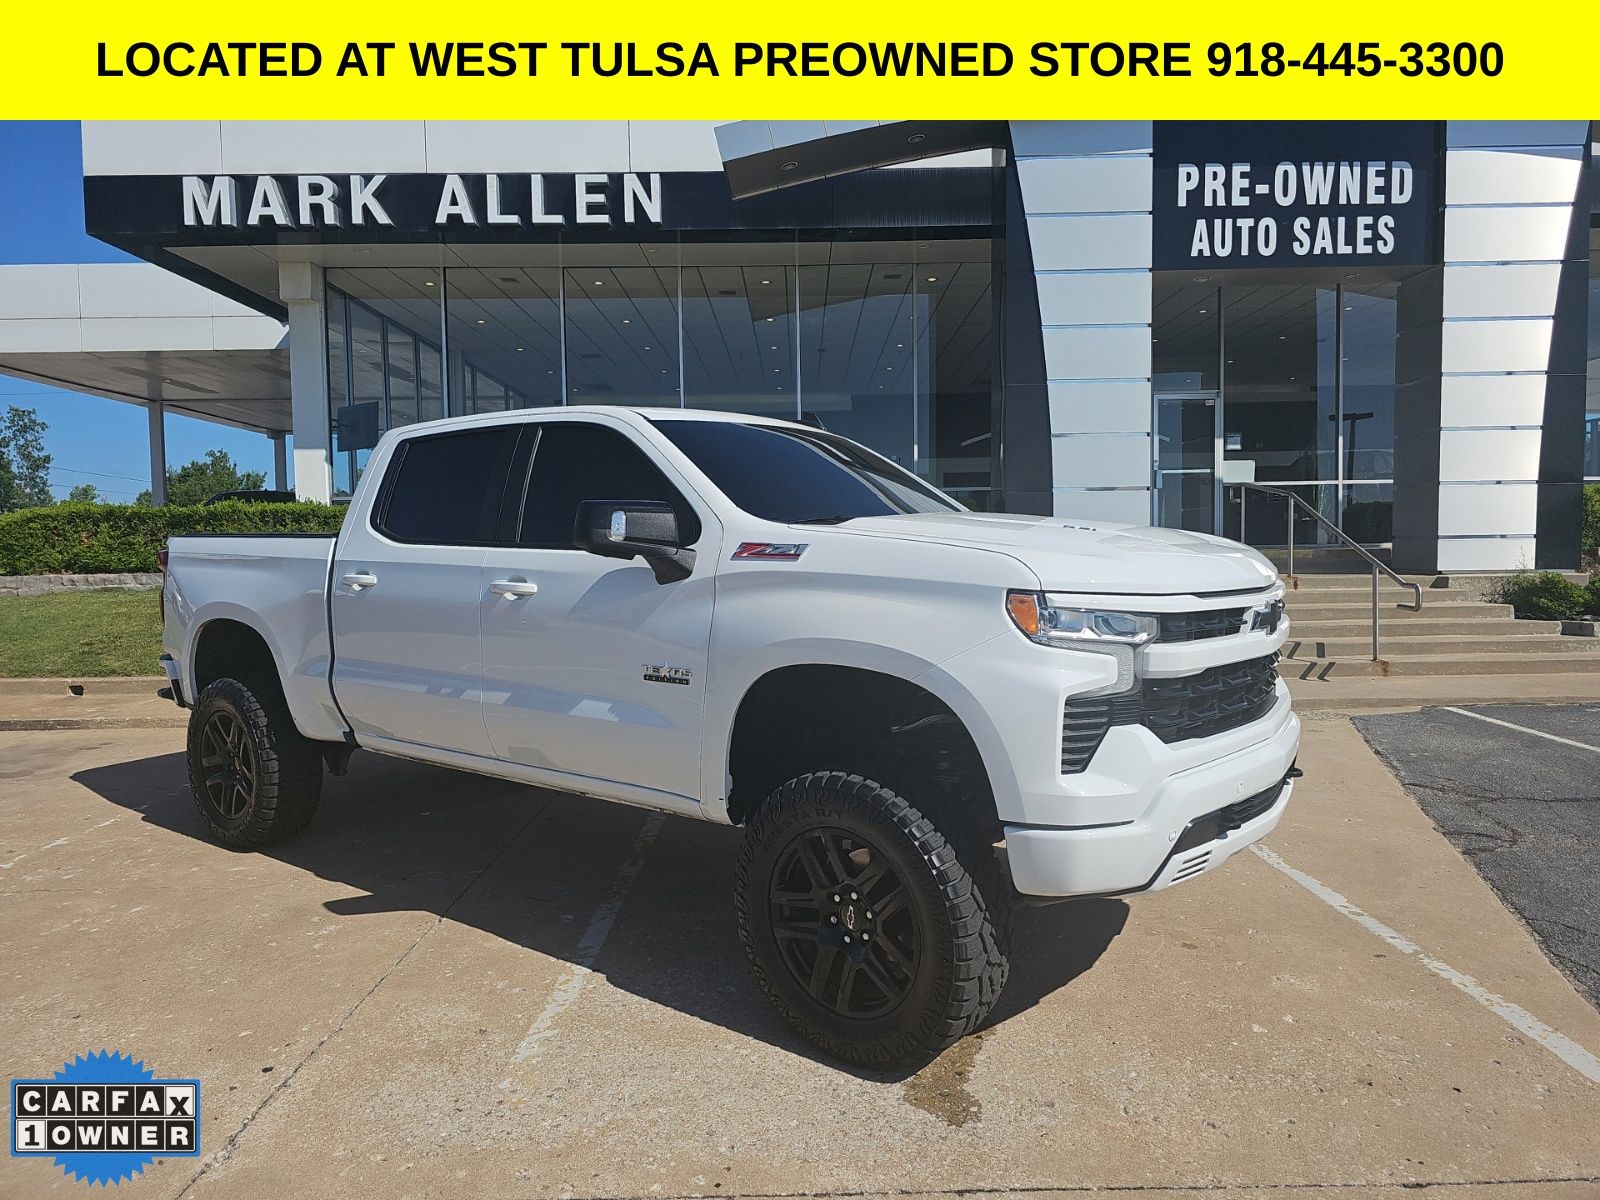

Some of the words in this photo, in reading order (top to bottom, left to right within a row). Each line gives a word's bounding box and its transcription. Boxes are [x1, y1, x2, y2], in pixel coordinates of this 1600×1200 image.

[183, 175, 394, 226] MARK
[435, 173, 662, 225] ALLEN
[1178, 161, 1413, 206] PRE-OWNED
[1190, 217, 1277, 257] AUTO
[1293, 215, 1395, 256] SALES
[730, 542, 811, 562] Z71
